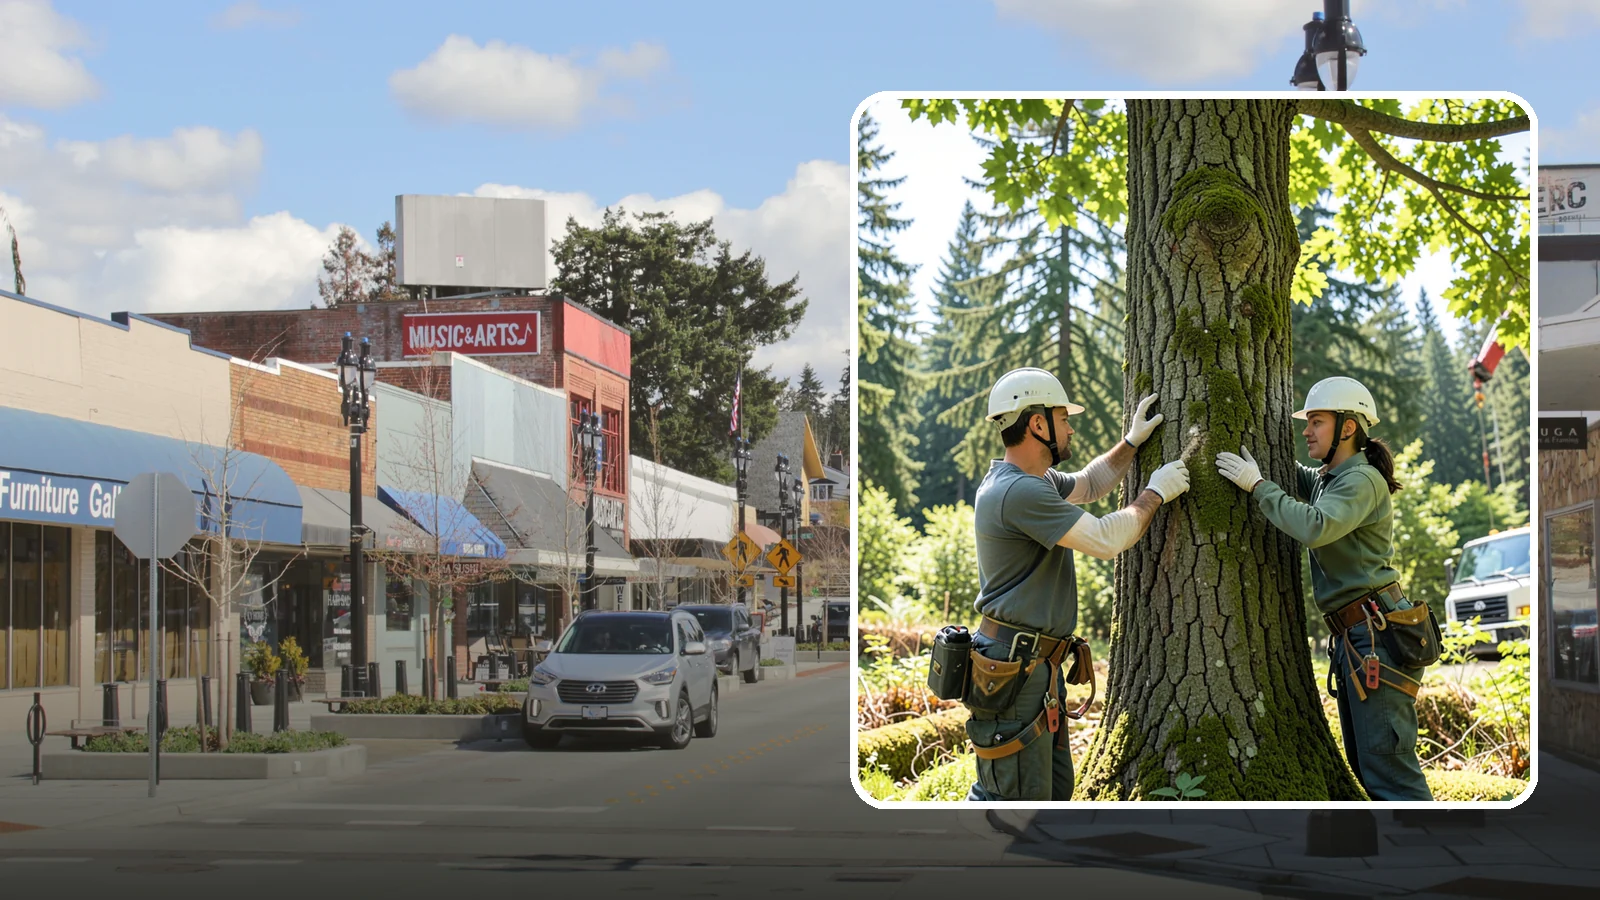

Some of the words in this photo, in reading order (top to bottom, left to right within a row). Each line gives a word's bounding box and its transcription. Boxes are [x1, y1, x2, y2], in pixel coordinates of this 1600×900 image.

[408, 322, 520, 349] MUSIC&ARTS
[1540, 427, 1578, 437] UGA
[0, 471, 80, 516] Furniture
[89, 482, 122, 519] Gal
[453, 562, 480, 575] SUSHI
